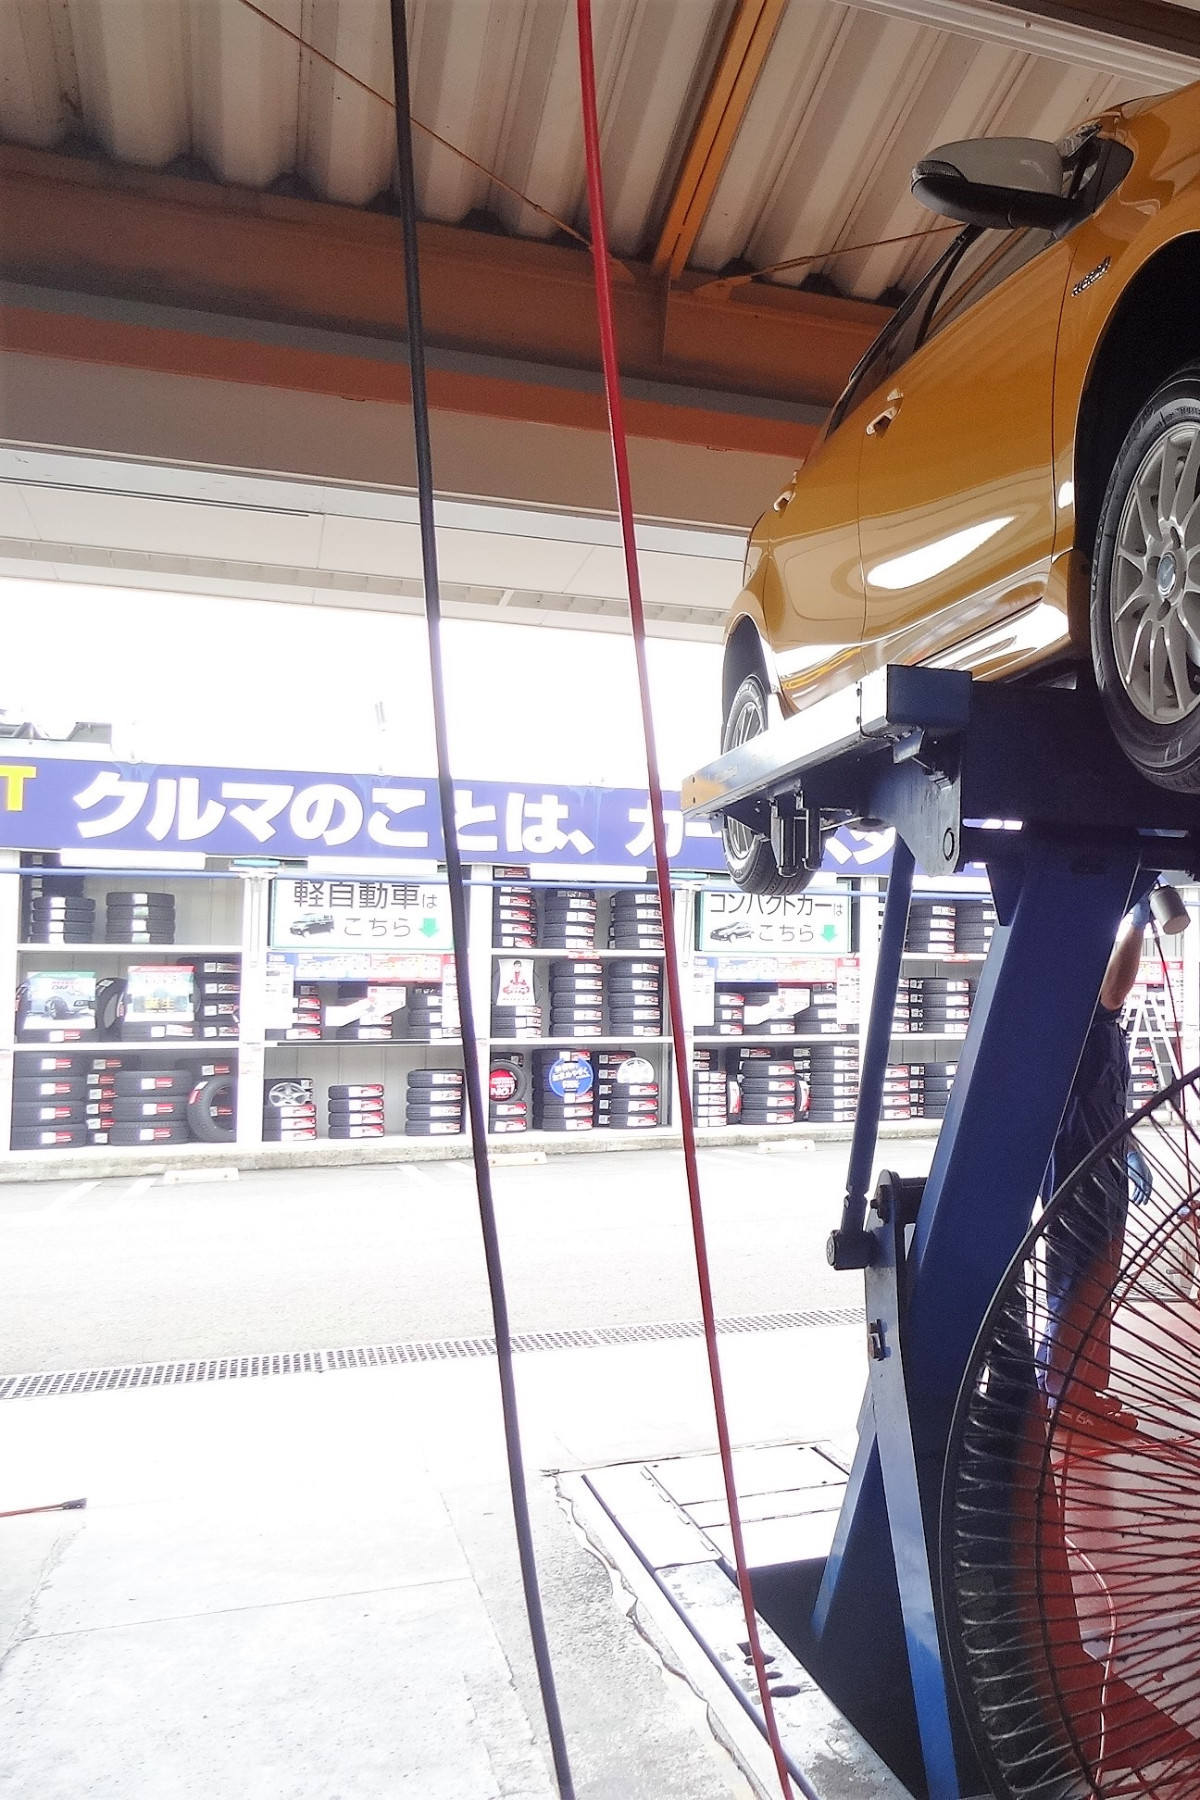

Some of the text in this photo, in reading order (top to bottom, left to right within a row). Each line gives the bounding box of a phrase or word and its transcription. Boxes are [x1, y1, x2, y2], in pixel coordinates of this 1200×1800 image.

[294, 880, 438, 910] 軽自動車は
[344, 917, 411, 938] こちら
[759, 924, 815, 942] こちら
